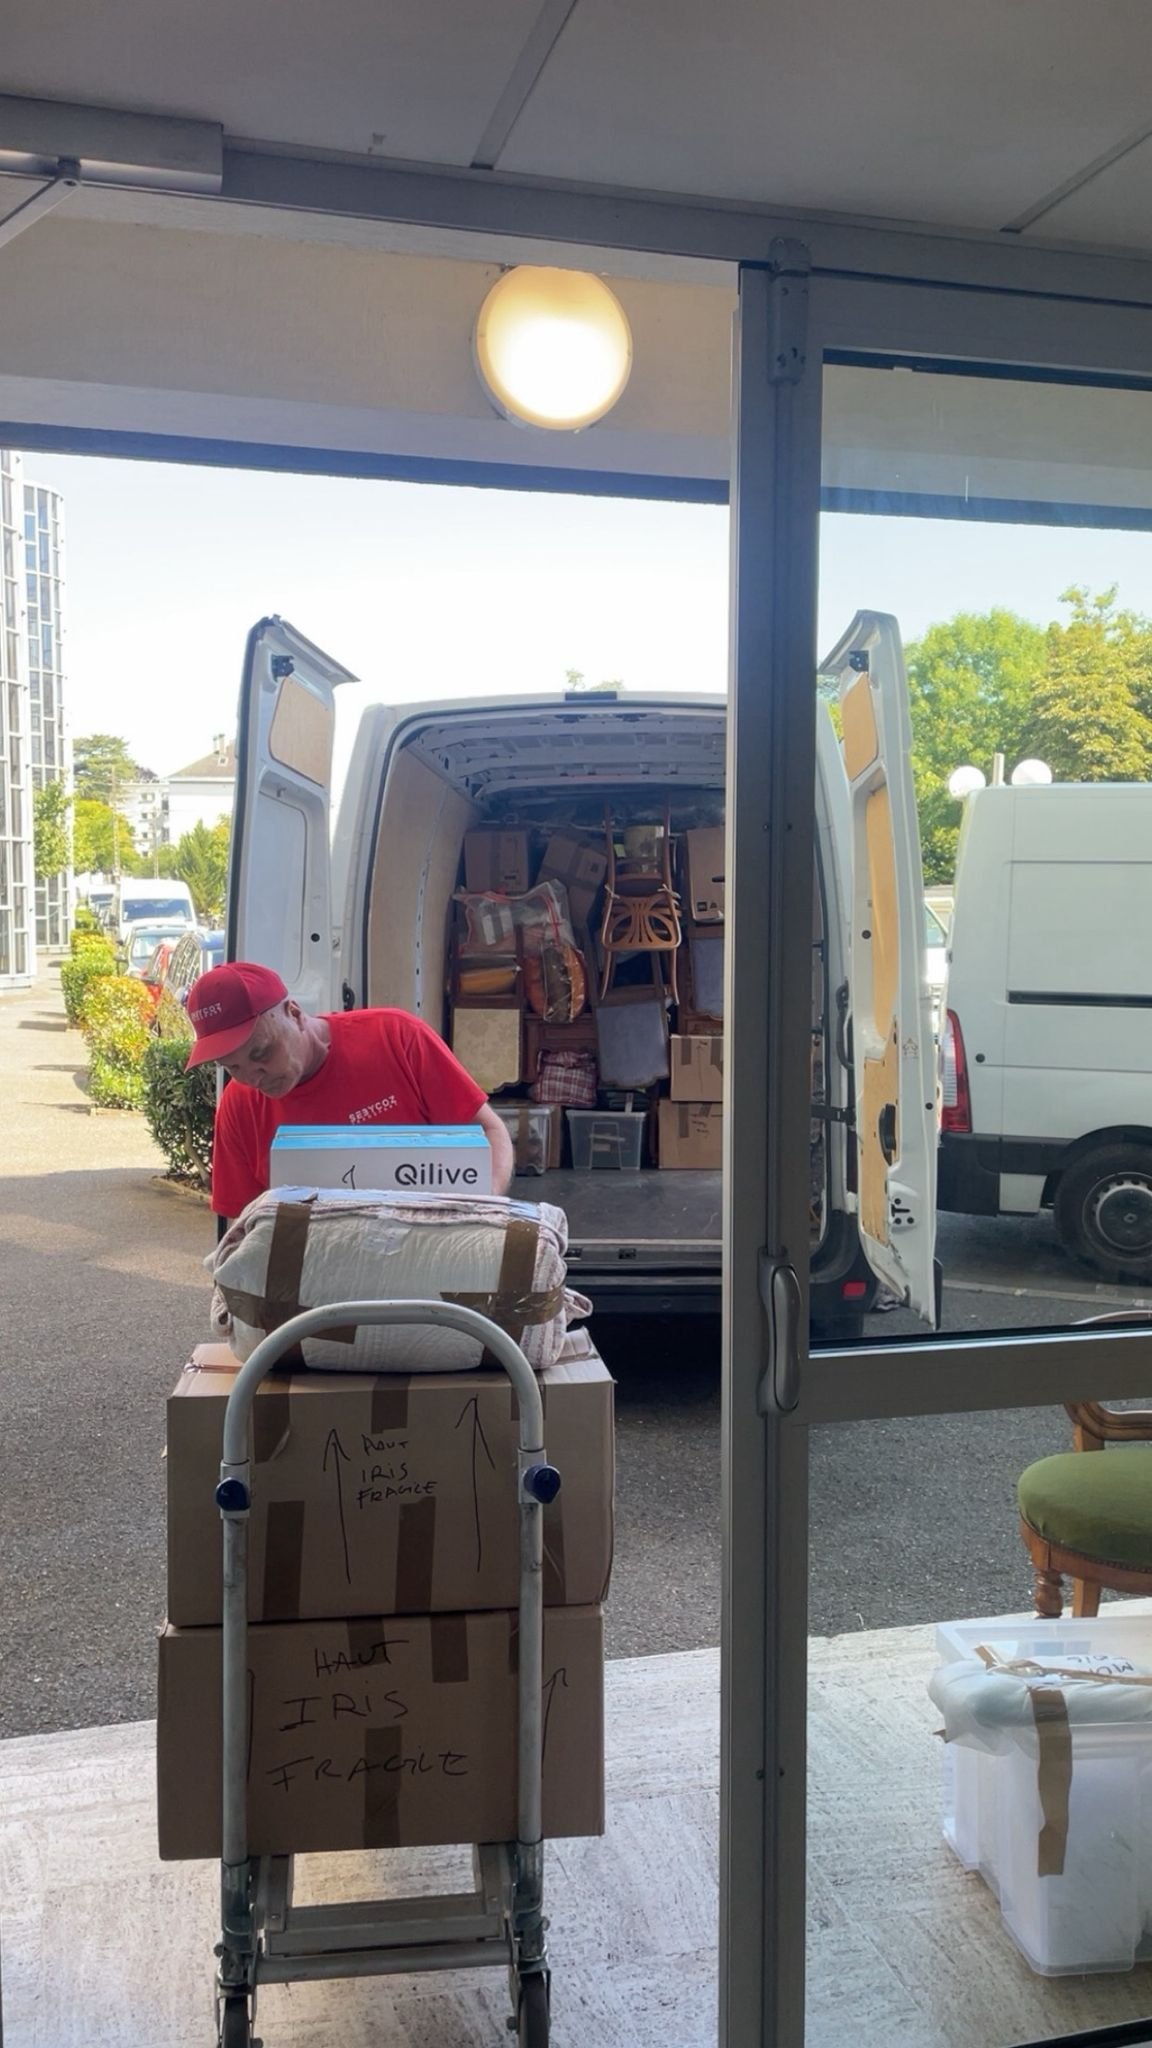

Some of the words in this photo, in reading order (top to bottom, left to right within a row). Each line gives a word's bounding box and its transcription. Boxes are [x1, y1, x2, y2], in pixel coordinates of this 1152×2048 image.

[394, 1162, 478, 1186] Qilive
[356, 1480, 438, 1510] FRAGILE
[314, 1639, 410, 1678] HAUT
[265, 1746, 469, 1792] FRAGILE
